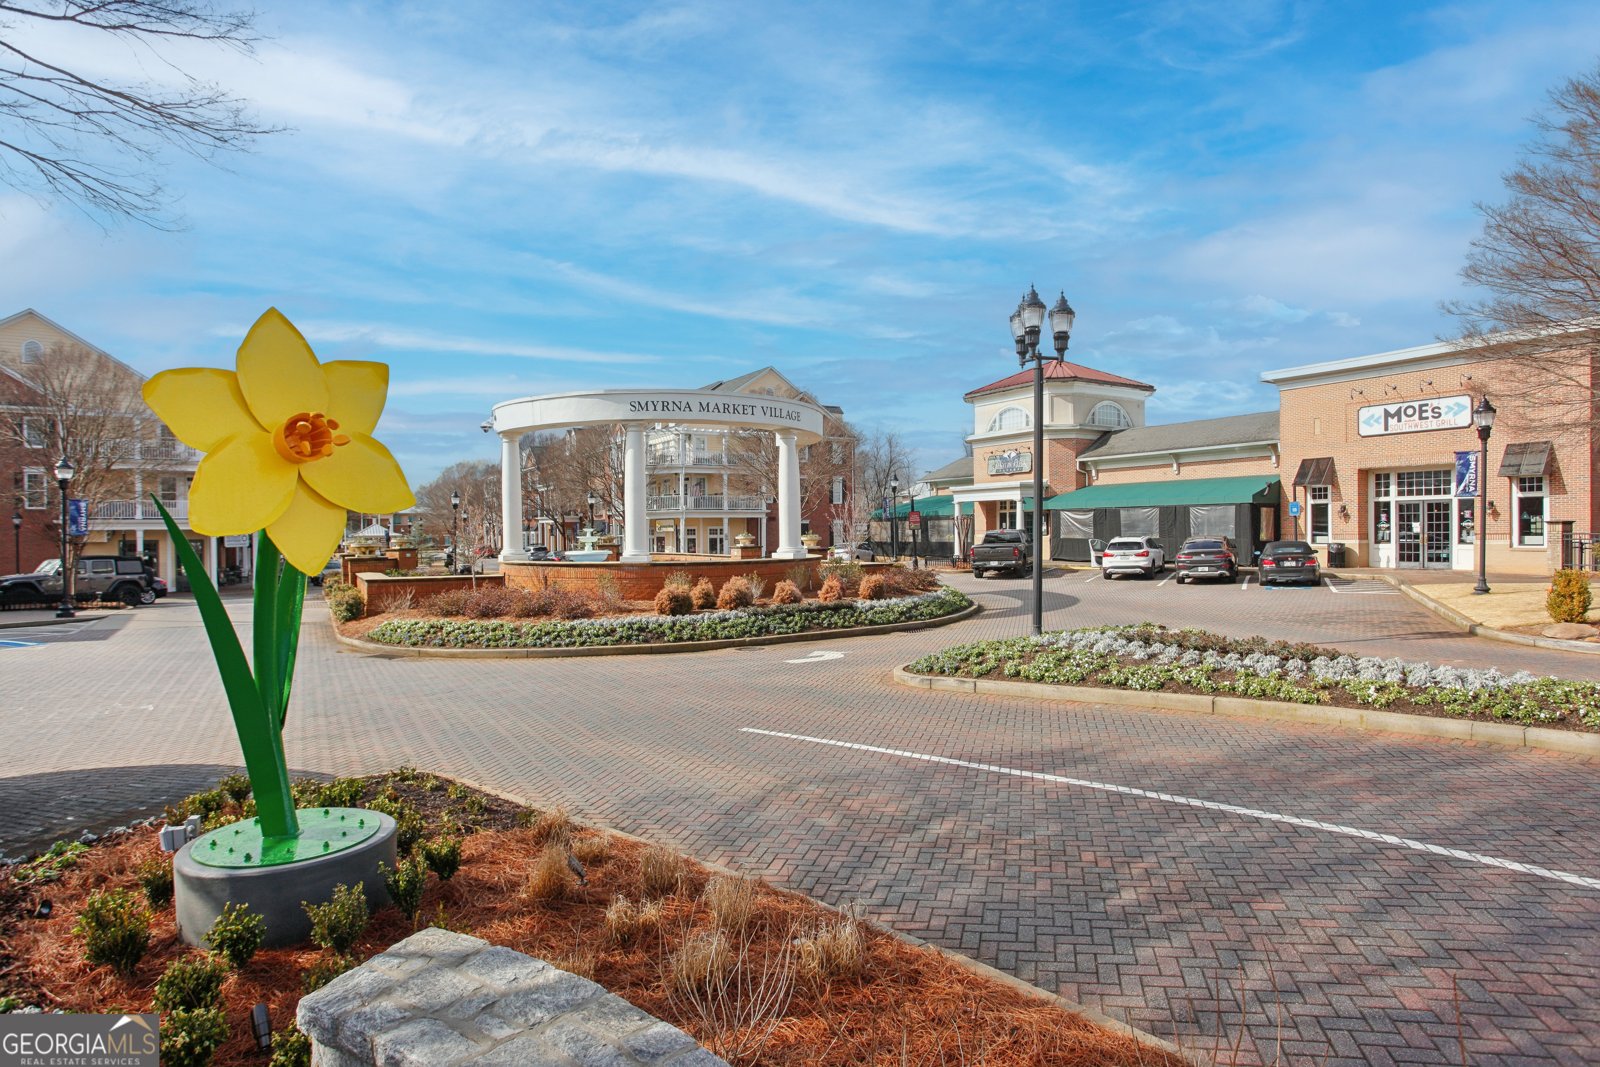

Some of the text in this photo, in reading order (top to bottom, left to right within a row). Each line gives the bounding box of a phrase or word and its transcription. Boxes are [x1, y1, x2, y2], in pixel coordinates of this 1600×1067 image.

[629, 400, 802, 422] SMYRNA MARKET VILLAGE
[1390, 419, 1459, 432] SOUTHWEST GRILL
[1468, 453, 1477, 492] SMYRNA
